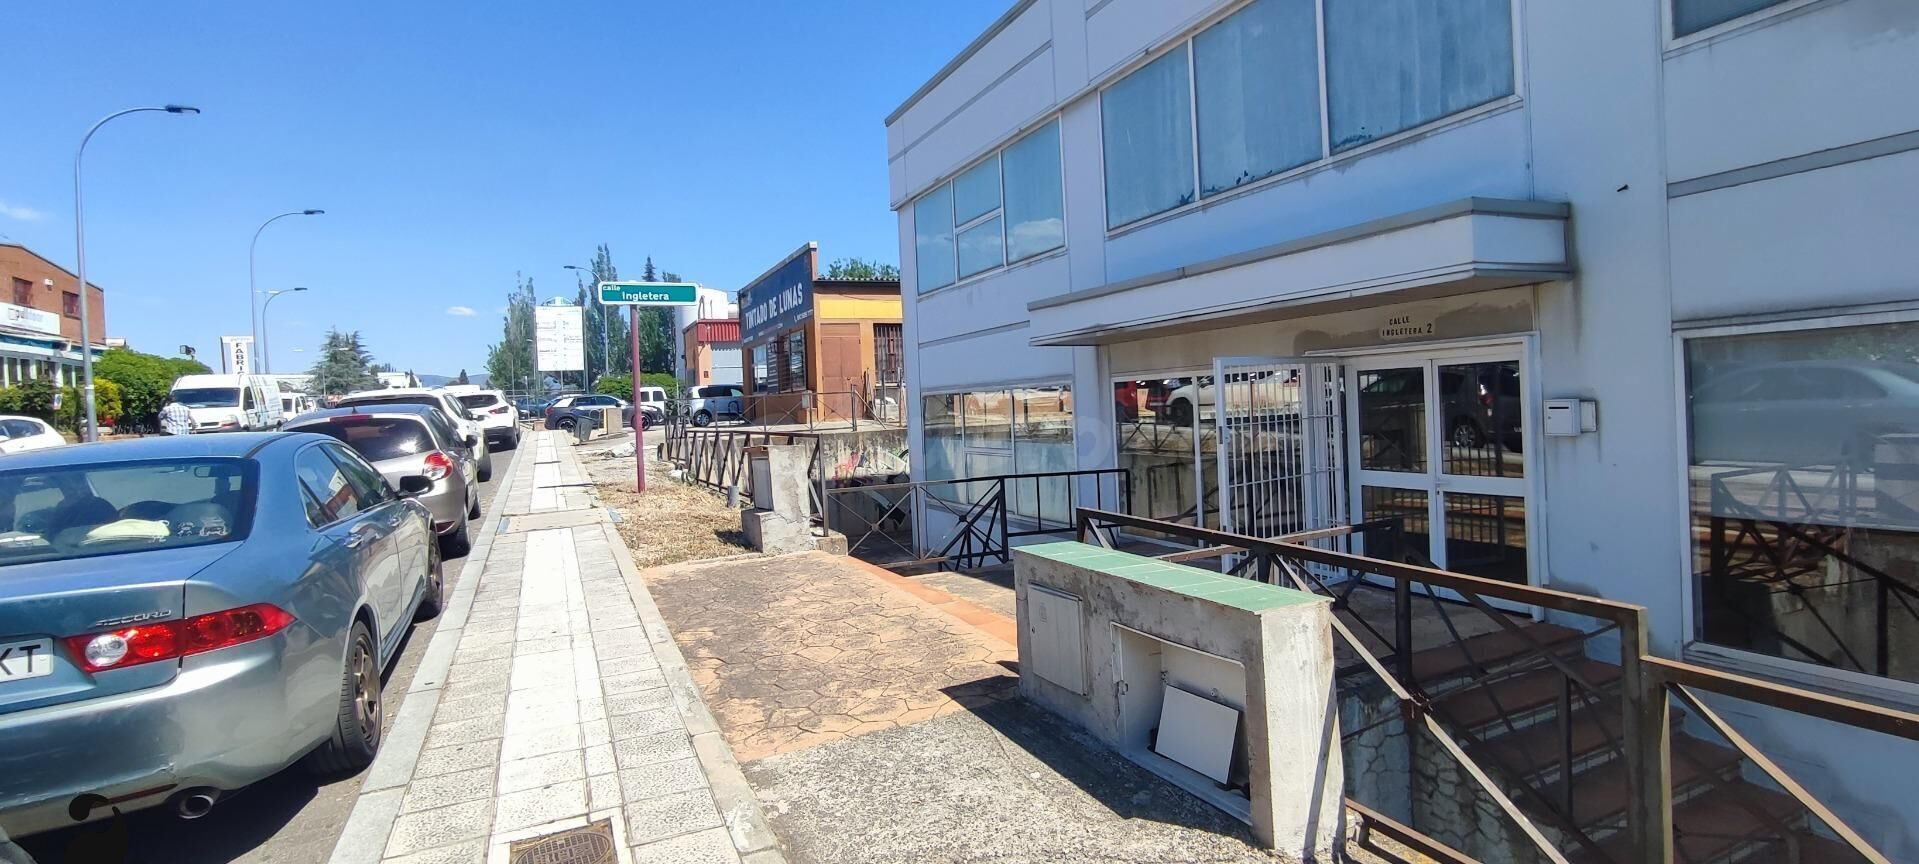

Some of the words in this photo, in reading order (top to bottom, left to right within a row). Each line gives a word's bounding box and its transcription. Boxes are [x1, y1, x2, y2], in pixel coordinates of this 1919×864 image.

[622, 291, 669, 301] Ingletera
[769, 297, 777, 319] DE
[779, 282, 803, 313] LUNAS
[1389, 316, 1409, 325] CALLE
[1382, 328, 1422, 336] INGLETERA
[1427, 323, 1432, 334] 2
